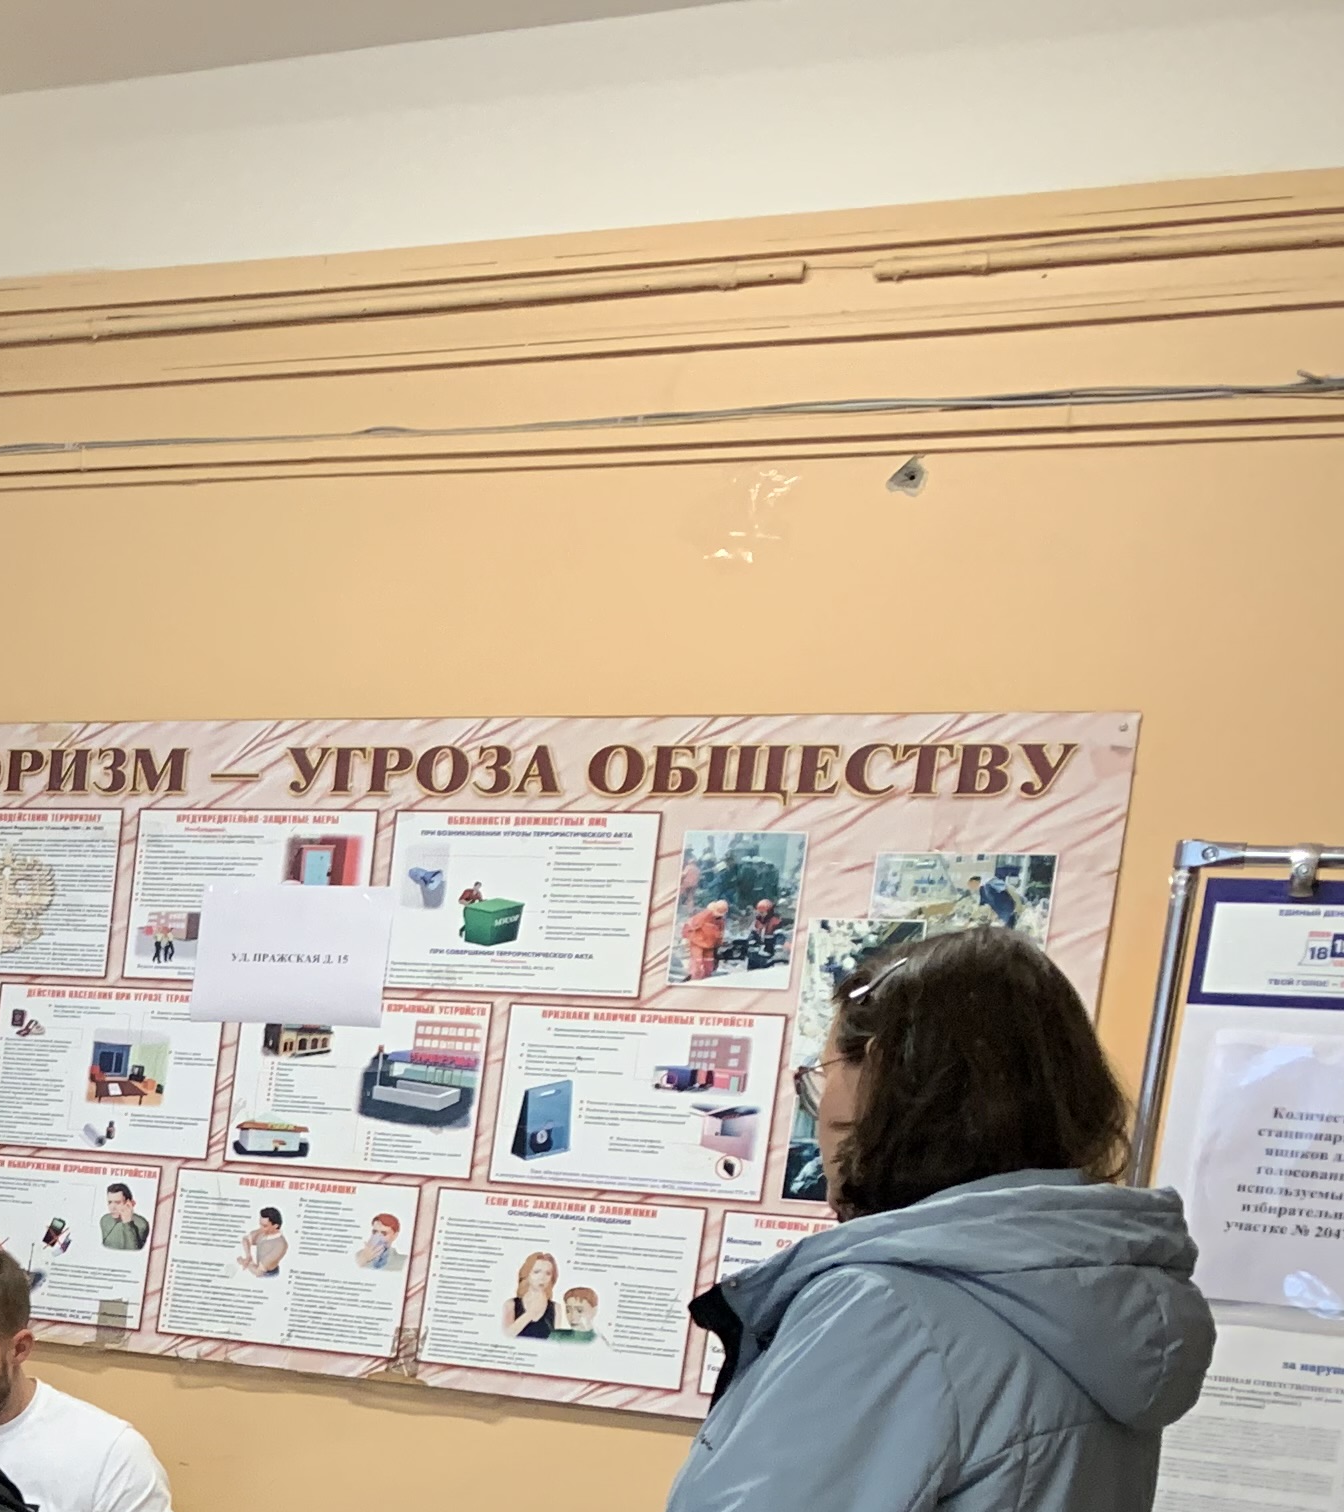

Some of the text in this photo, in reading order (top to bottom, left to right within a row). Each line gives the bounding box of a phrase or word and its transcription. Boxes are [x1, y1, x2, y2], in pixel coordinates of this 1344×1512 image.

[287, 744, 562, 797] УГРОЗА
[586, 743, 1078, 806] ОБЩЕСТВУ
[51, 813, 102, 823] ТЕРРОРИЗМУ
[312, 815, 340, 824] МЕРЫ
[1279, 908, 1344, 918] ЕДИНЫЙ ДЕН
[253, 953, 321, 964] ПРАЖСКАЯ
[337, 954, 350, 964] 15
[1309, 947, 1328, 960] 18
[165, 993, 190, 1003] ТЕРАК
[1273, 1107, 1344, 1123] Количес
[1257, 1128, 1344, 1145] стационар
[1236, 1184, 1344, 1200] используемы
[1241, 1202, 1344, 1219] избирательн
[754, 1219, 809, 1231] ТЕЛЕФОНЫ
[1223, 1220, 1344, 1239] участке № 204
